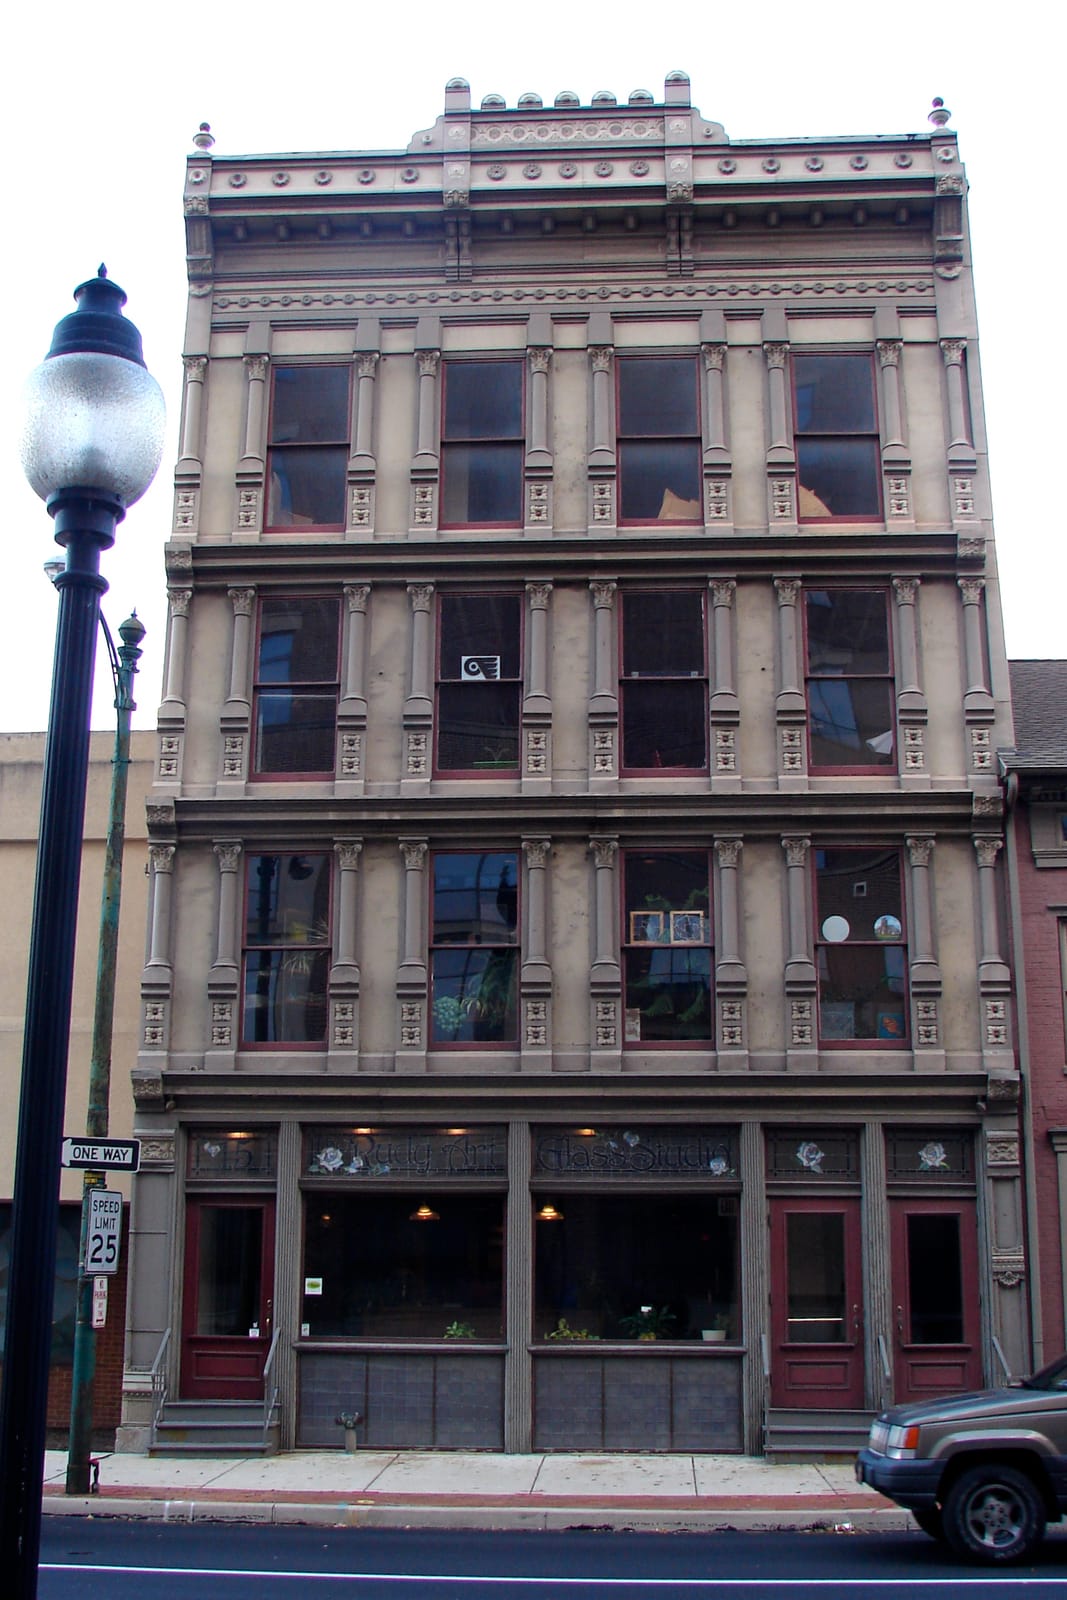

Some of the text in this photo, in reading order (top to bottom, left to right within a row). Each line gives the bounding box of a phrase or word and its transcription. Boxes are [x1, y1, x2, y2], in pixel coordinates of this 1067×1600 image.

[73, 1147, 129, 1161] ONE WAY
[349, 1135, 431, 1174] Rudy
[442, 1135, 498, 1171] Art
[536, 1135, 732, 1171] Glass Studio
[93, 1200, 120, 1213] SPEED
[95, 1217, 116, 1230] LIMIT
[90, 1234, 117, 1263] 25
